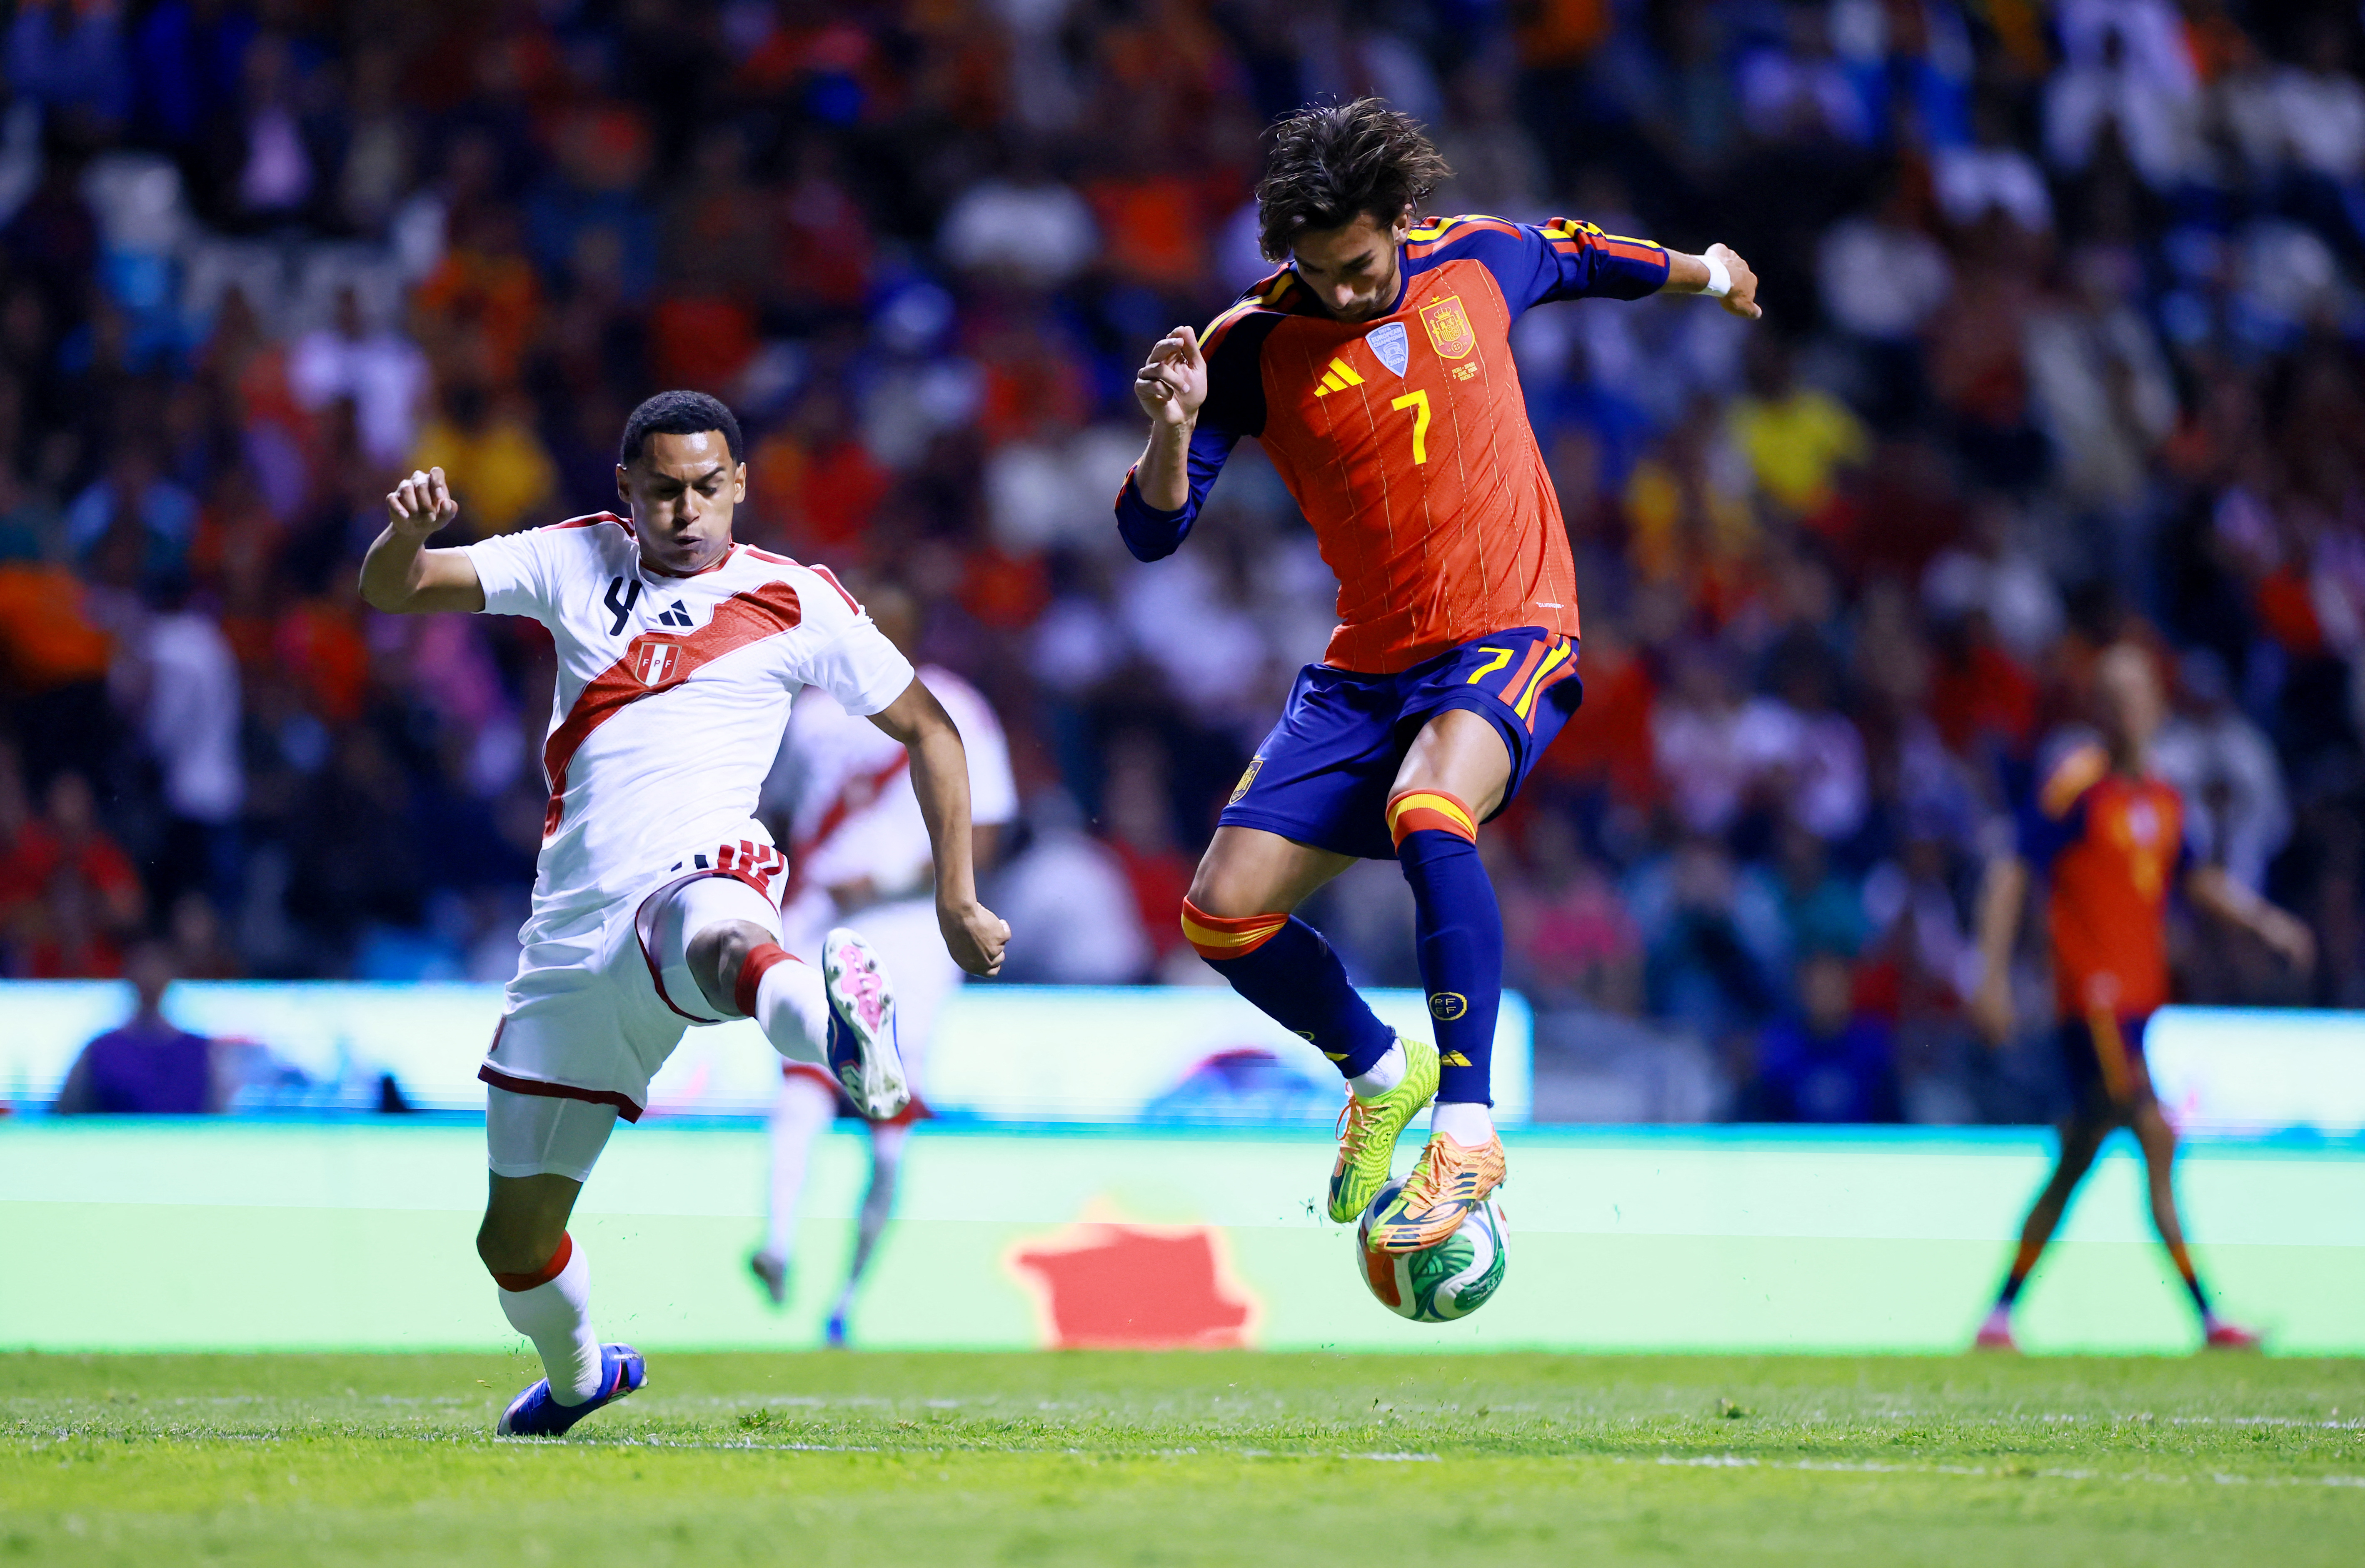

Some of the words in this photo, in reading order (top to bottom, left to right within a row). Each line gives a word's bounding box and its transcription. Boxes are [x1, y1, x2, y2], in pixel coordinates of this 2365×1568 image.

[1371, 327, 1402, 342] EUROPEAN
[1374, 333, 1404, 348] CHAMPIONS
[1389, 356, 1405, 366] 2024
[1459, 372, 1474, 382] PUEBLA
[1391, 389, 1431, 465] 7
[604, 576, 643, 636] 4
[1466, 647, 1514, 684] 7
